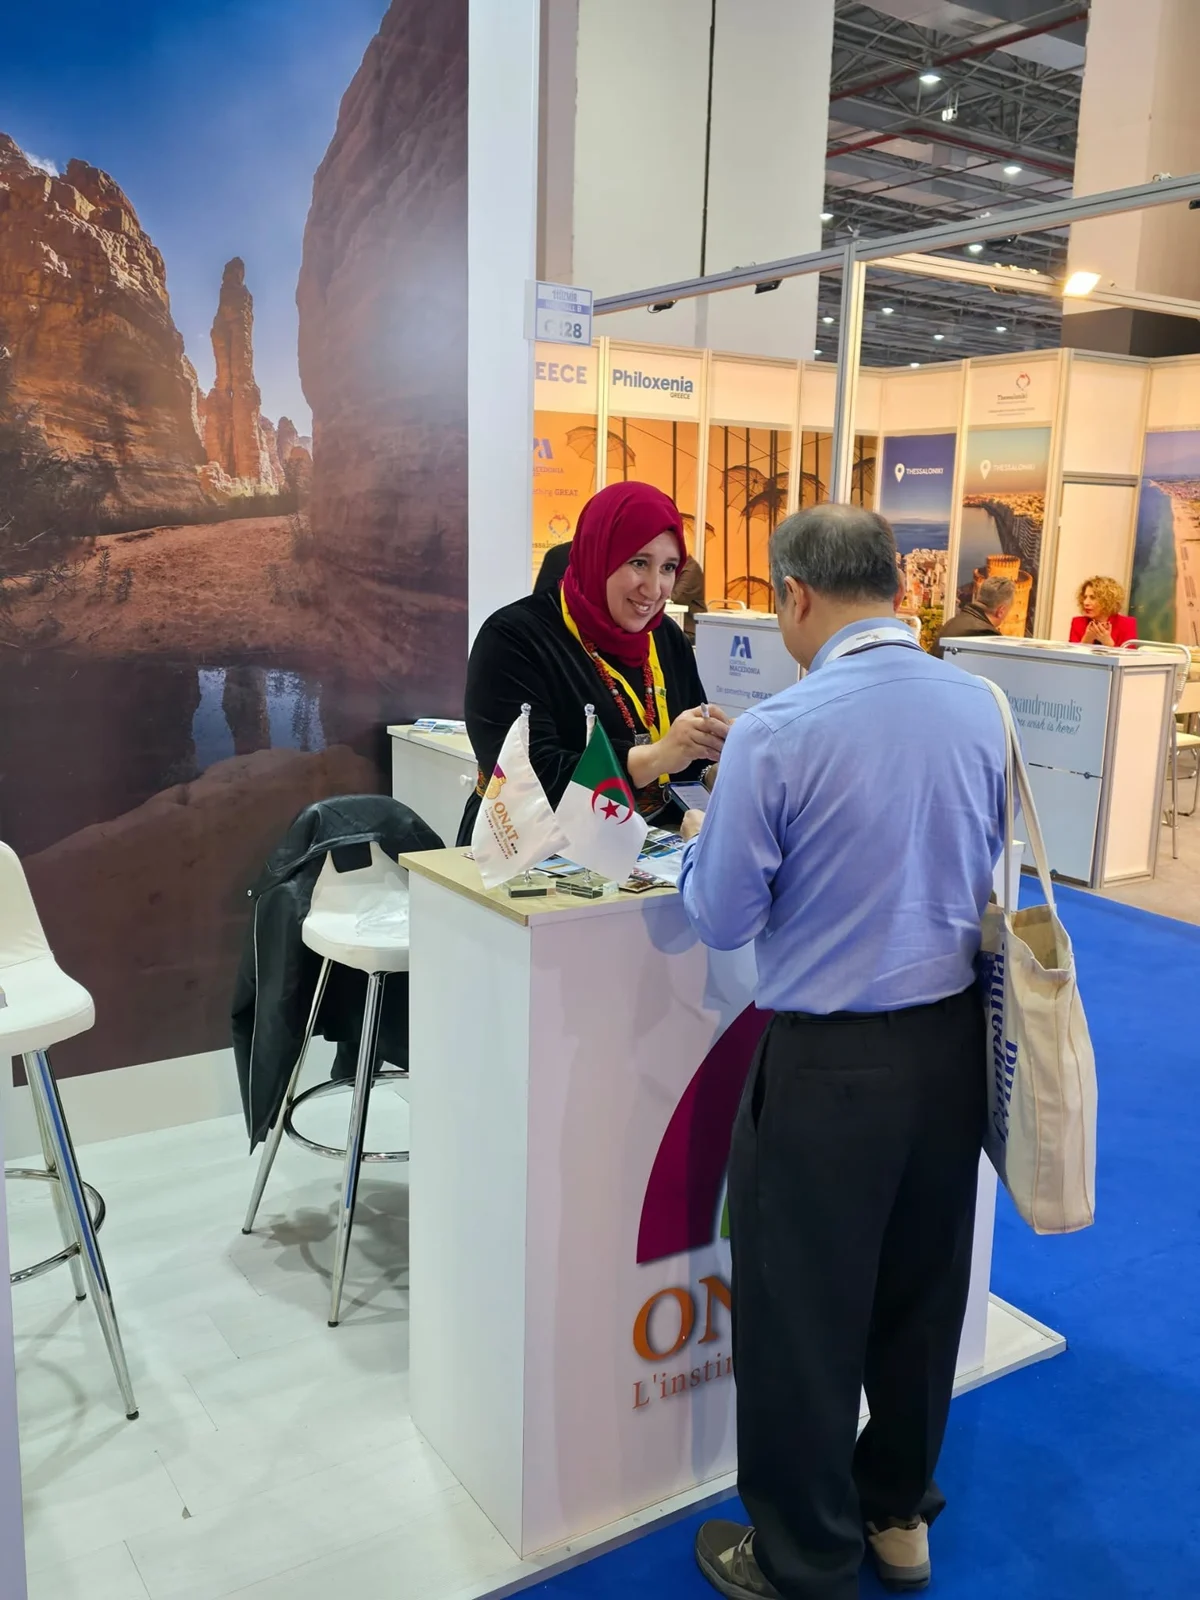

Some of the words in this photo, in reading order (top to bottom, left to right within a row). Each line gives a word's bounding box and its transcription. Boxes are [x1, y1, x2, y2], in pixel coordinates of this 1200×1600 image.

[612, 369, 693, 393] Philoxenia
[670, 392, 690, 400] GREECE
[906, 467, 944, 475] THESSALONIKI
[993, 463, 1036, 472] THESSALONIKI
[494, 801, 519, 841] ONAT
